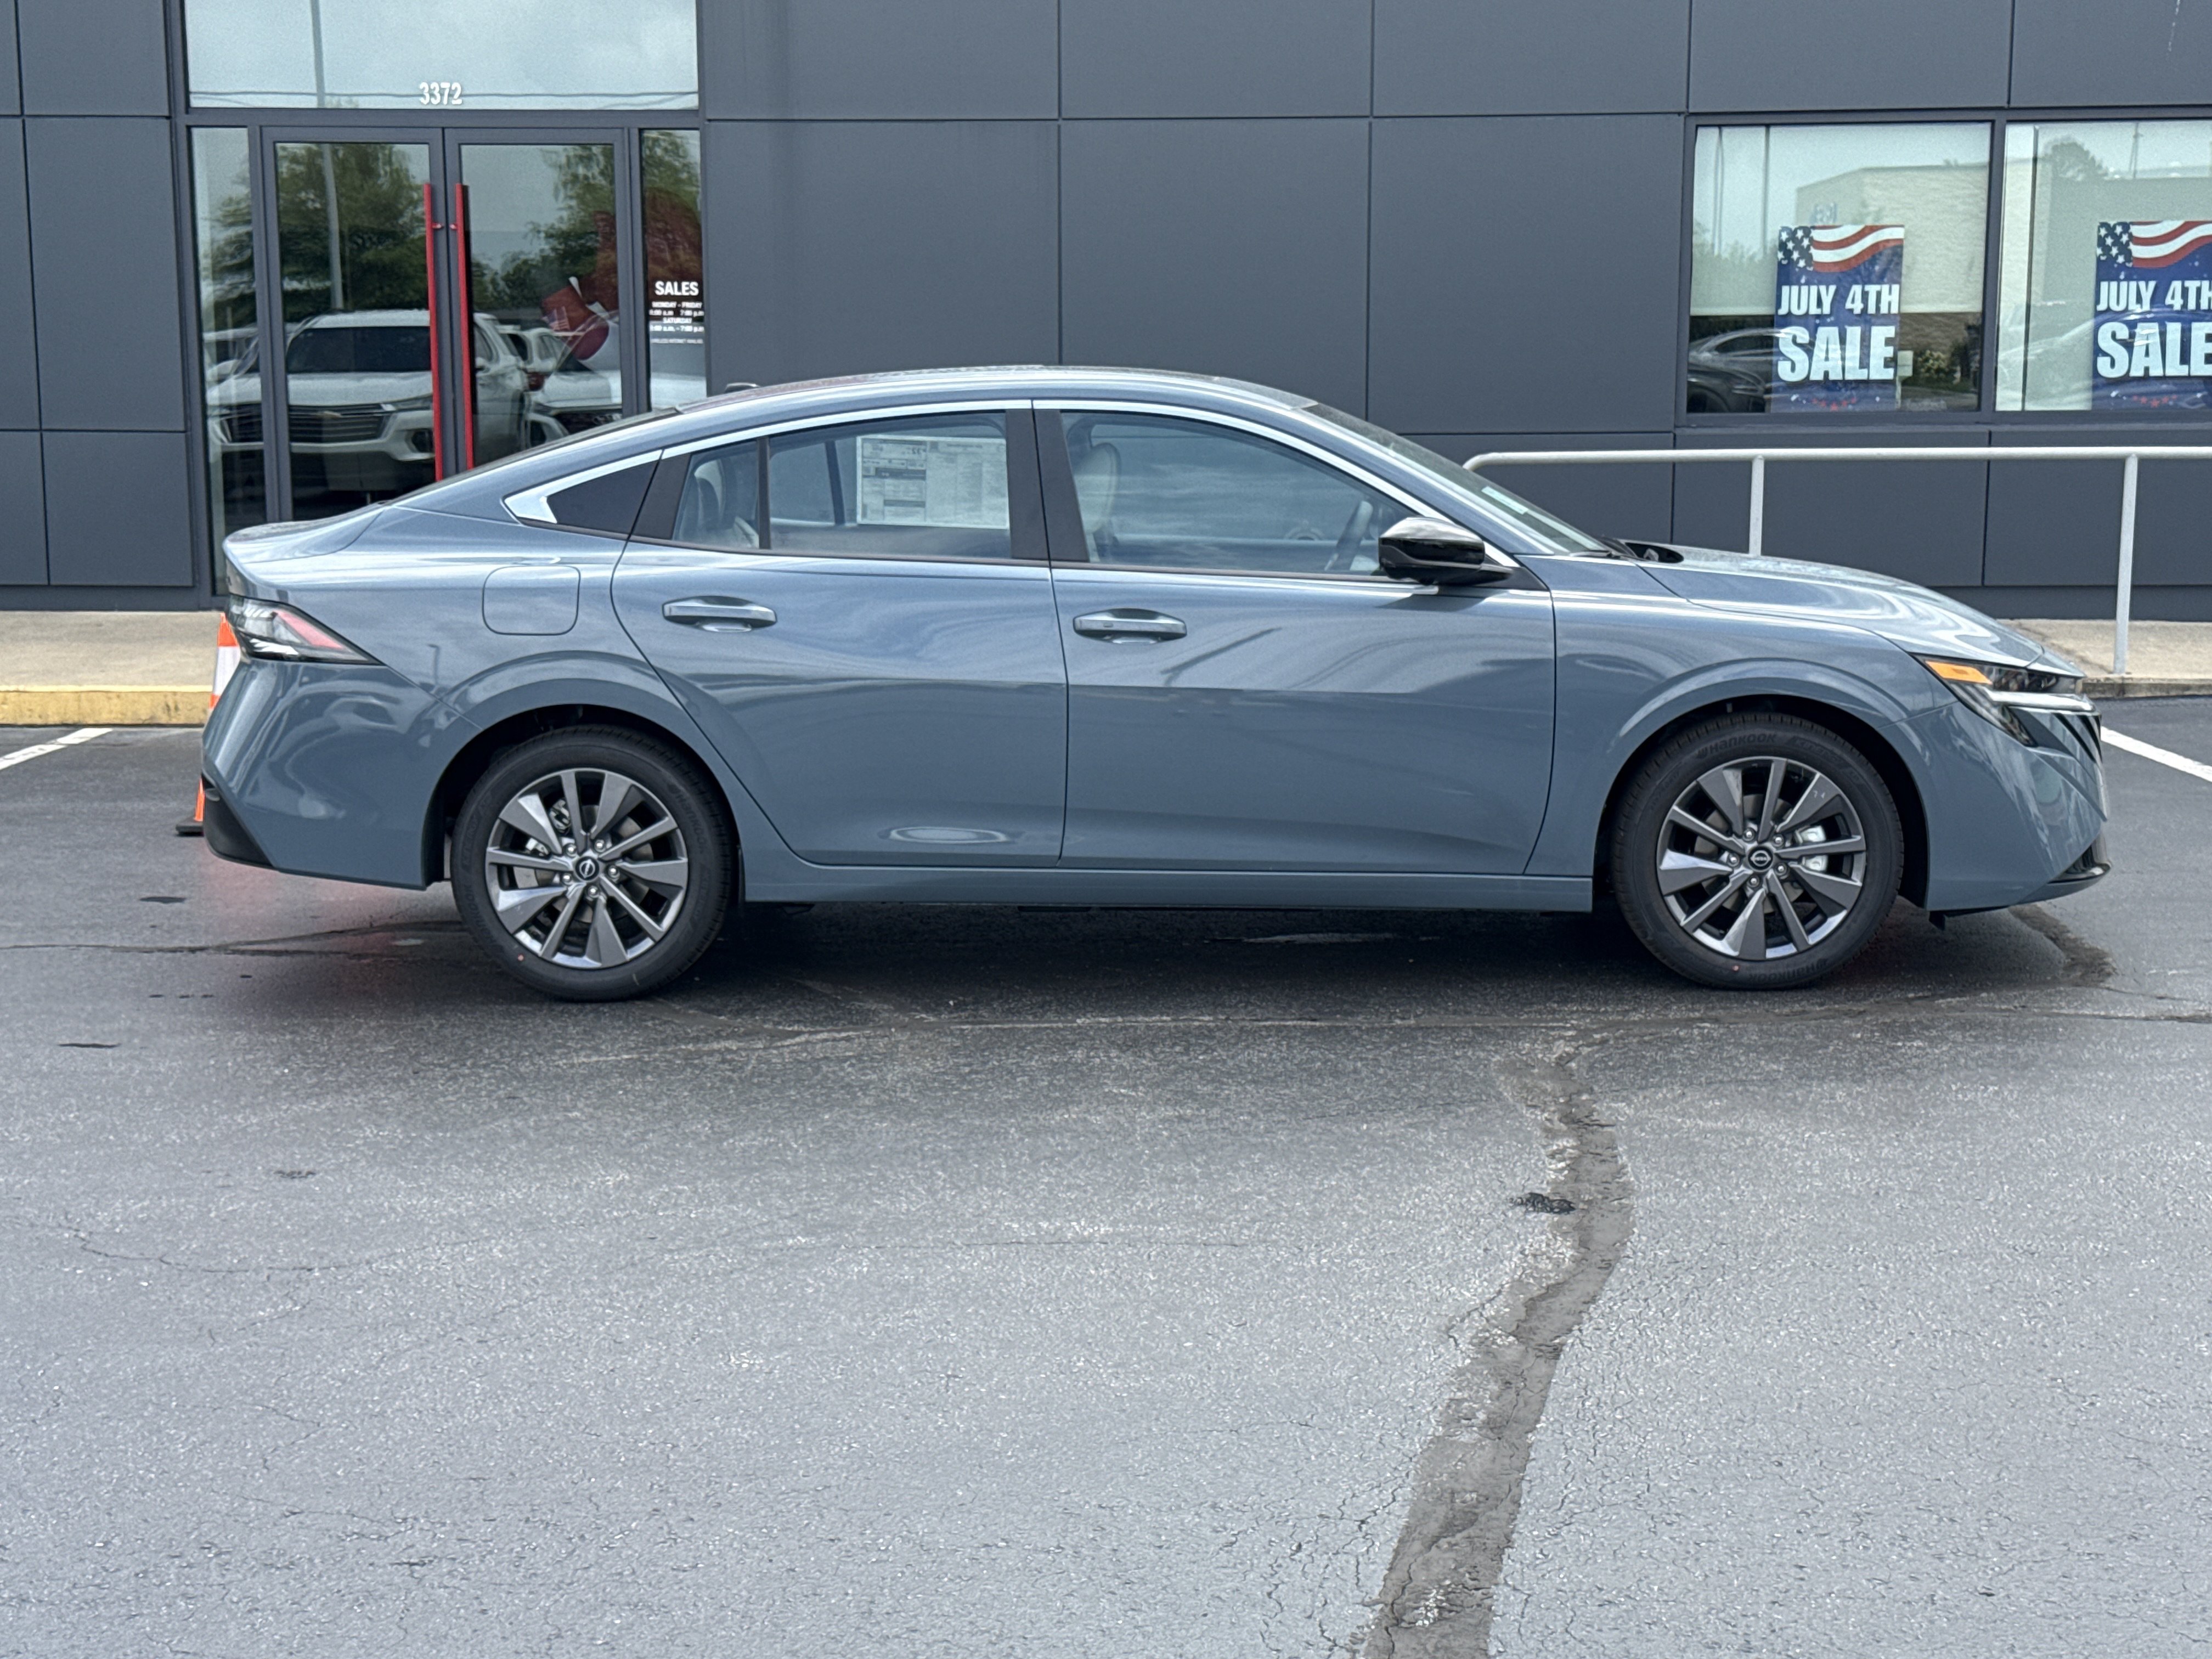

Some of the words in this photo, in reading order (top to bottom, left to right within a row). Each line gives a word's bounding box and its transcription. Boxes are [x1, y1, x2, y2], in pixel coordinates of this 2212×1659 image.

[419, 82, 462, 105] 3372
[654, 281, 699, 296] SALES
[1778, 285, 1836, 315] JULY
[1845, 284, 1900, 315] 4TH
[2096, 281, 2157, 311] JULY
[1778, 326, 1895, 382] SALE
[2097, 321, 2212, 378] SALE
